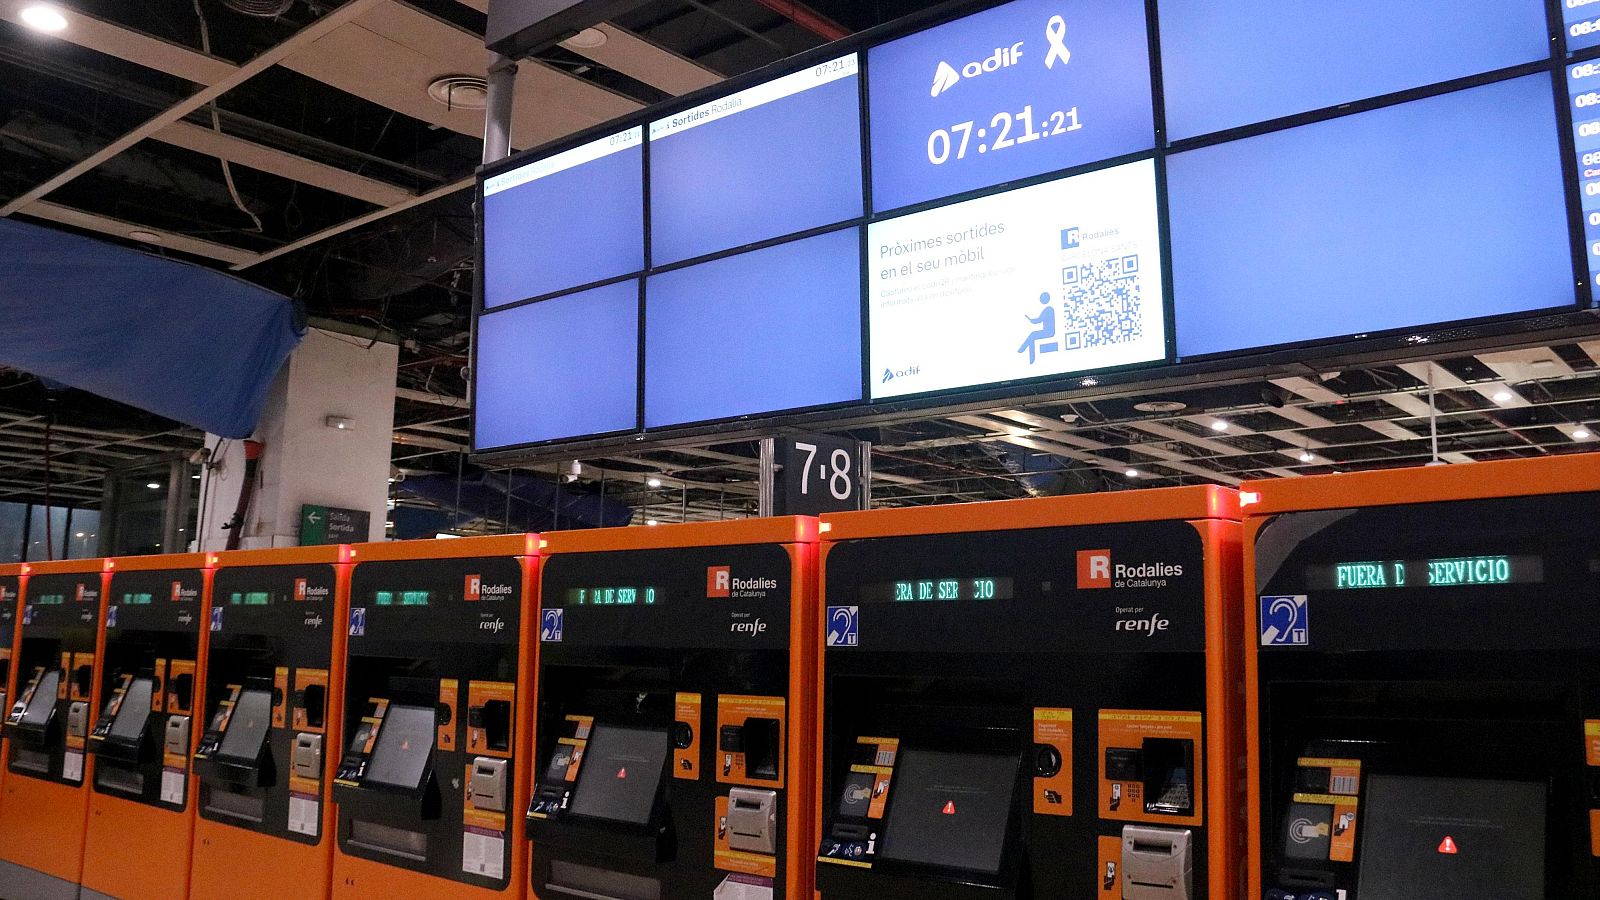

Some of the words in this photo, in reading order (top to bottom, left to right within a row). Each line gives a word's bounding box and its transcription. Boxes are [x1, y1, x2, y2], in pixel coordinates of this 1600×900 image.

[962, 41, 1024, 78] adif
[1571, 63, 1600, 79] 08:
[1575, 91, 1600, 108] 08:
[672, 108, 710, 128] Sortides
[711, 96, 742, 116] Rodalia
[927, 105, 1083, 165] 07:21:21
[880, 236, 942, 259] Pròximes
[946, 222, 1005, 245] sortides
[1082, 228, 1119, 241] Rodalies
[880, 267, 897, 280] en
[900, 261, 913, 276] el
[916, 258, 940, 273] seu
[944, 245, 985, 267] mòbil
[895, 364, 921, 378] adif
[1090, 555, 1110, 579] R
[1115, 562, 1183, 579] Rodalies
[1337, 564, 1387, 588] FUERA
[1395, 563, 1405, 586] D
[481, 584, 513, 596] Rodalies
[716, 571, 729, 590] R
[732, 577, 777, 590] Rodalies
[1115, 579, 1125, 588] de
[1126, 578, 1167, 589] Catalunya
[731, 590, 738, 598] de
[739, 589, 766, 599] Catalunya
[919, 581, 933, 600] DE
[479, 617, 505, 634] renfe
[731, 617, 766, 638] renfe
[1115, 612, 1169, 637] renfe
